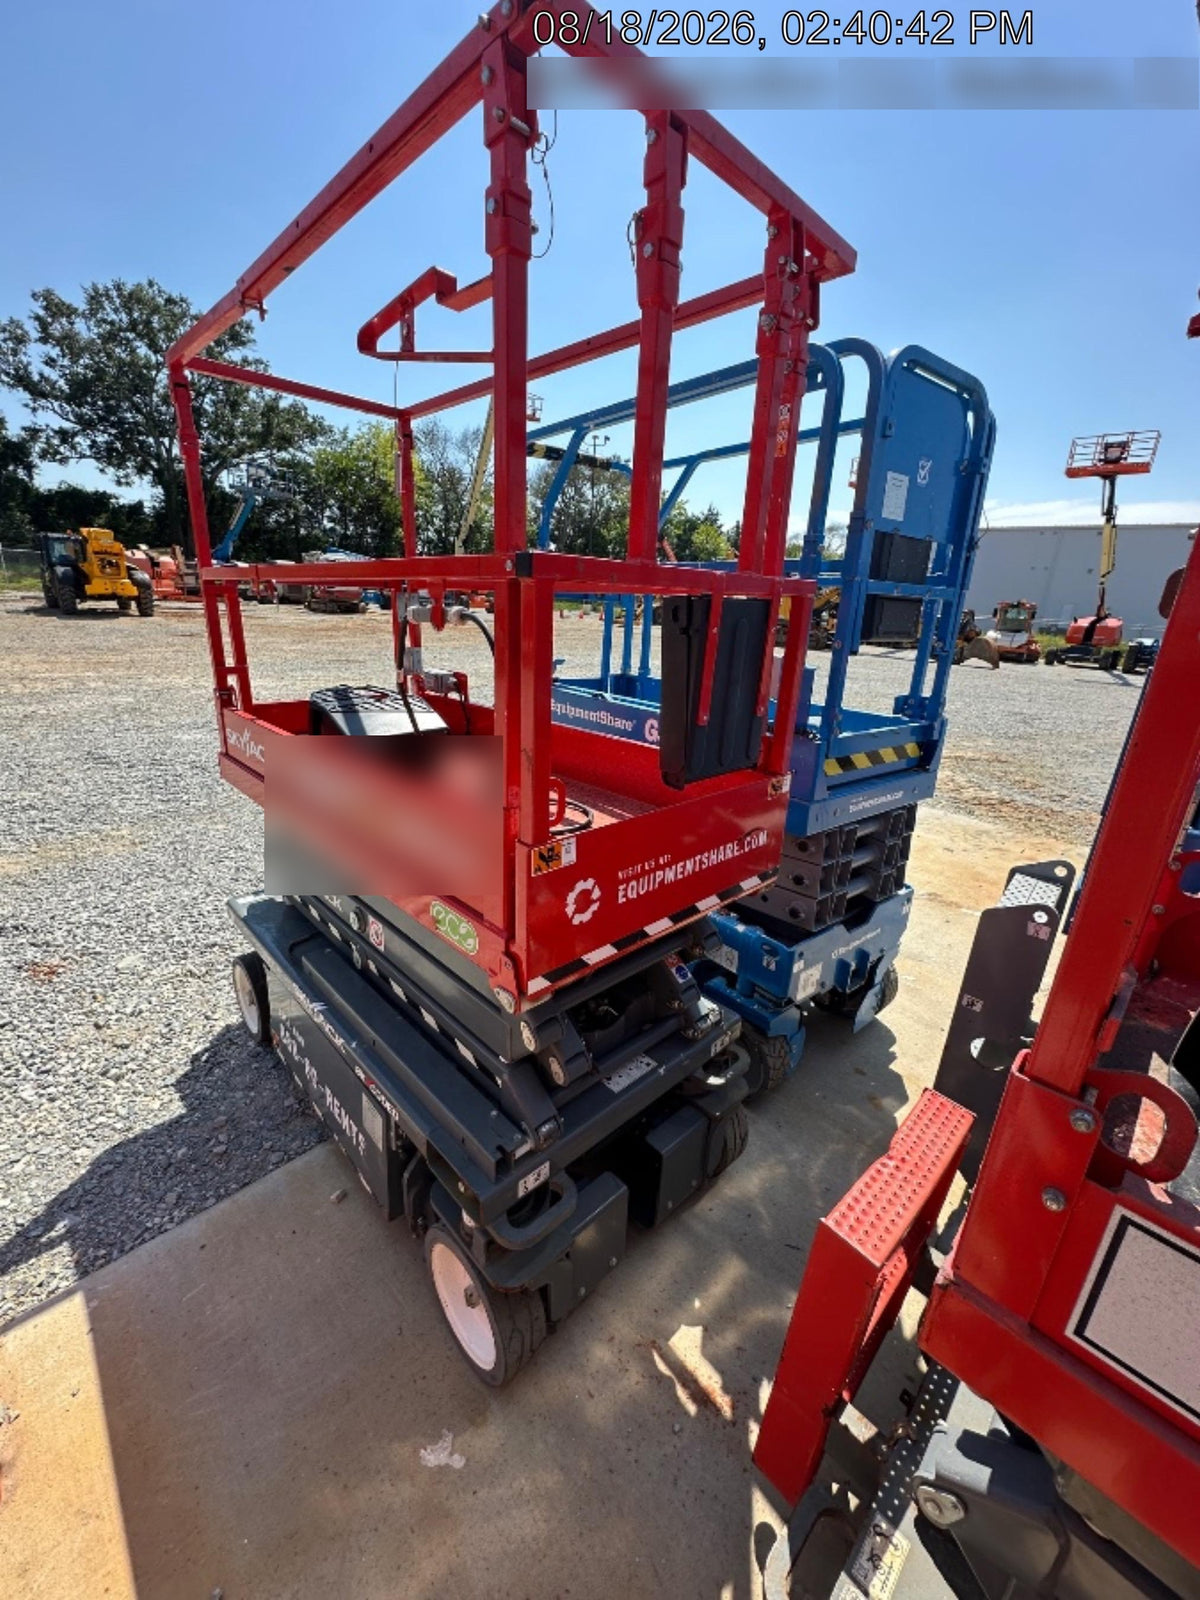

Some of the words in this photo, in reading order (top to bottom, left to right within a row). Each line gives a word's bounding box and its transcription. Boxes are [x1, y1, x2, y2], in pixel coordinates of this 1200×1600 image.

[617, 830, 769, 904] EQUIPMENTSHARE.COM
[617, 863, 643, 880] VISIT
[644, 858, 656, 870] US
